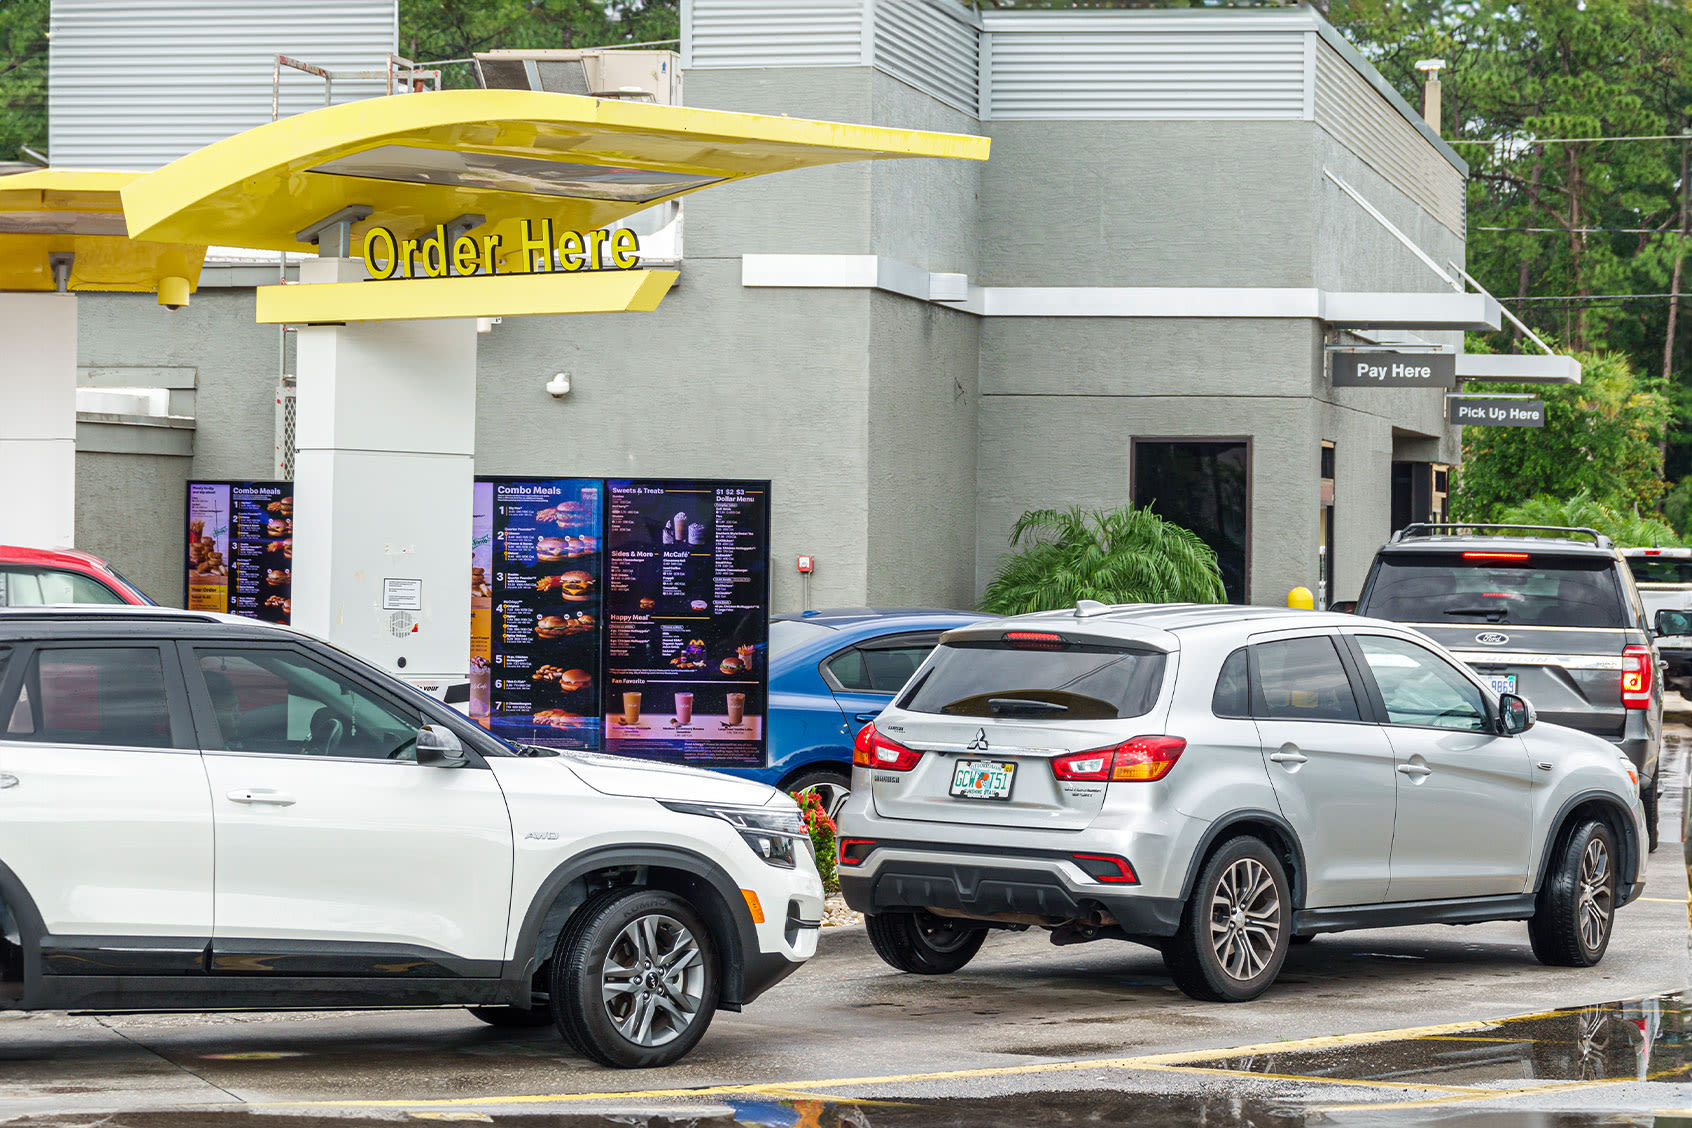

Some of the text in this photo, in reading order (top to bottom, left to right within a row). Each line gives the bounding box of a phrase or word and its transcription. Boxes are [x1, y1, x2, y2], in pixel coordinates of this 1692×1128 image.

[364, 218, 641, 281] Order Here
[1357, 363, 1432, 380] Pay Here
[1458, 406, 1540, 421] Pick Up Here
[259, 487, 281, 495] Meals
[497, 485, 561, 495] Combo Meals
[499, 506, 504, 515] 1
[232, 515, 238, 523] 2
[497, 531, 504, 540] 2
[231, 542, 238, 550] 3
[496, 572, 503, 581] 3
[231, 596, 237, 604] 5
[496, 604, 503, 613] 4
[495, 655, 502, 664] 5
[495, 679, 502, 688] 6
[1491, 680, 1514, 693] 9869
[495, 701, 502, 710] 7
[955, 769, 977, 788] GCW
[524, 831, 560, 840] AWD
